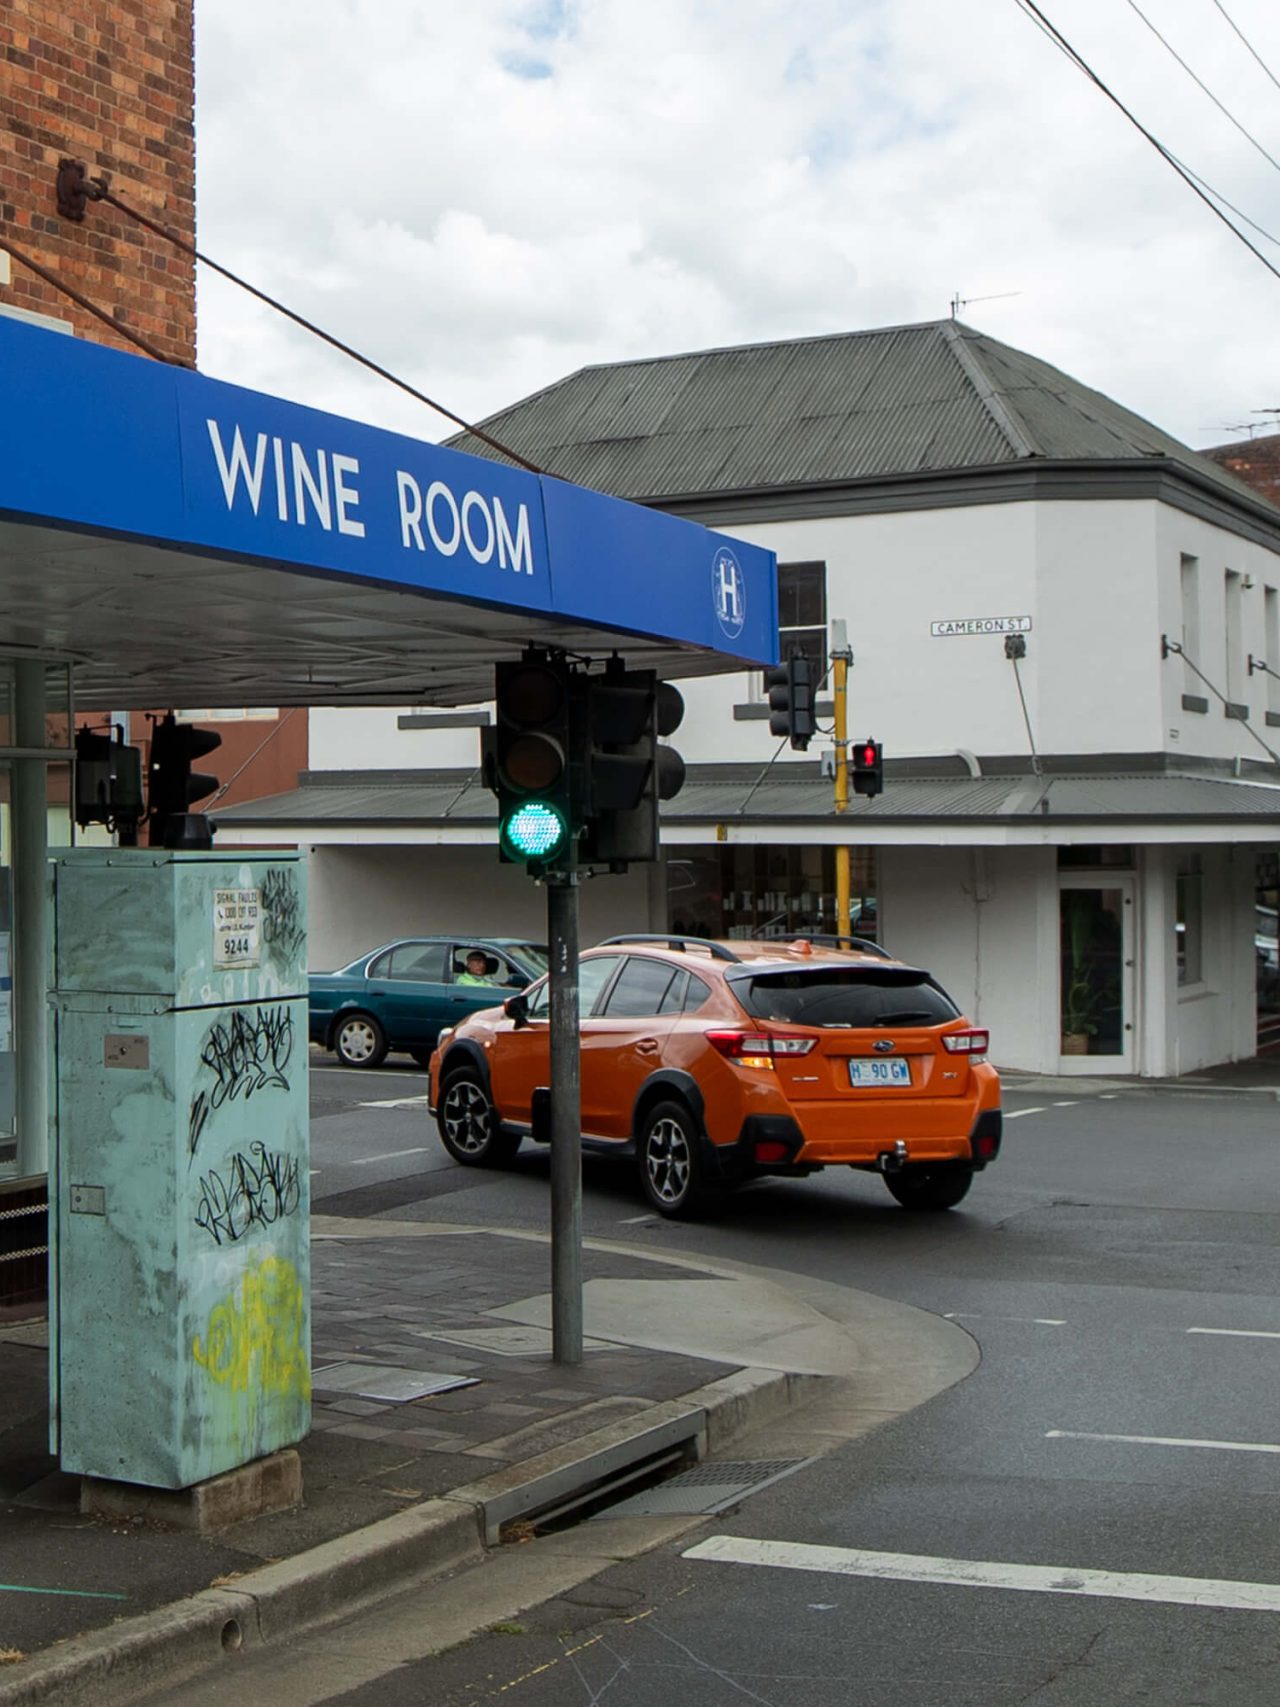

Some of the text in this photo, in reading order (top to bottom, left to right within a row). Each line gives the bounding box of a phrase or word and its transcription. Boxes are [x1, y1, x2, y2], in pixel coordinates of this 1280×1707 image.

[207, 419, 533, 576] WINE ROOM
[937, 620, 1004, 634] CAMERON
[224, 938, 249, 955] 9244
[872, 1063, 888, 1079] 90
